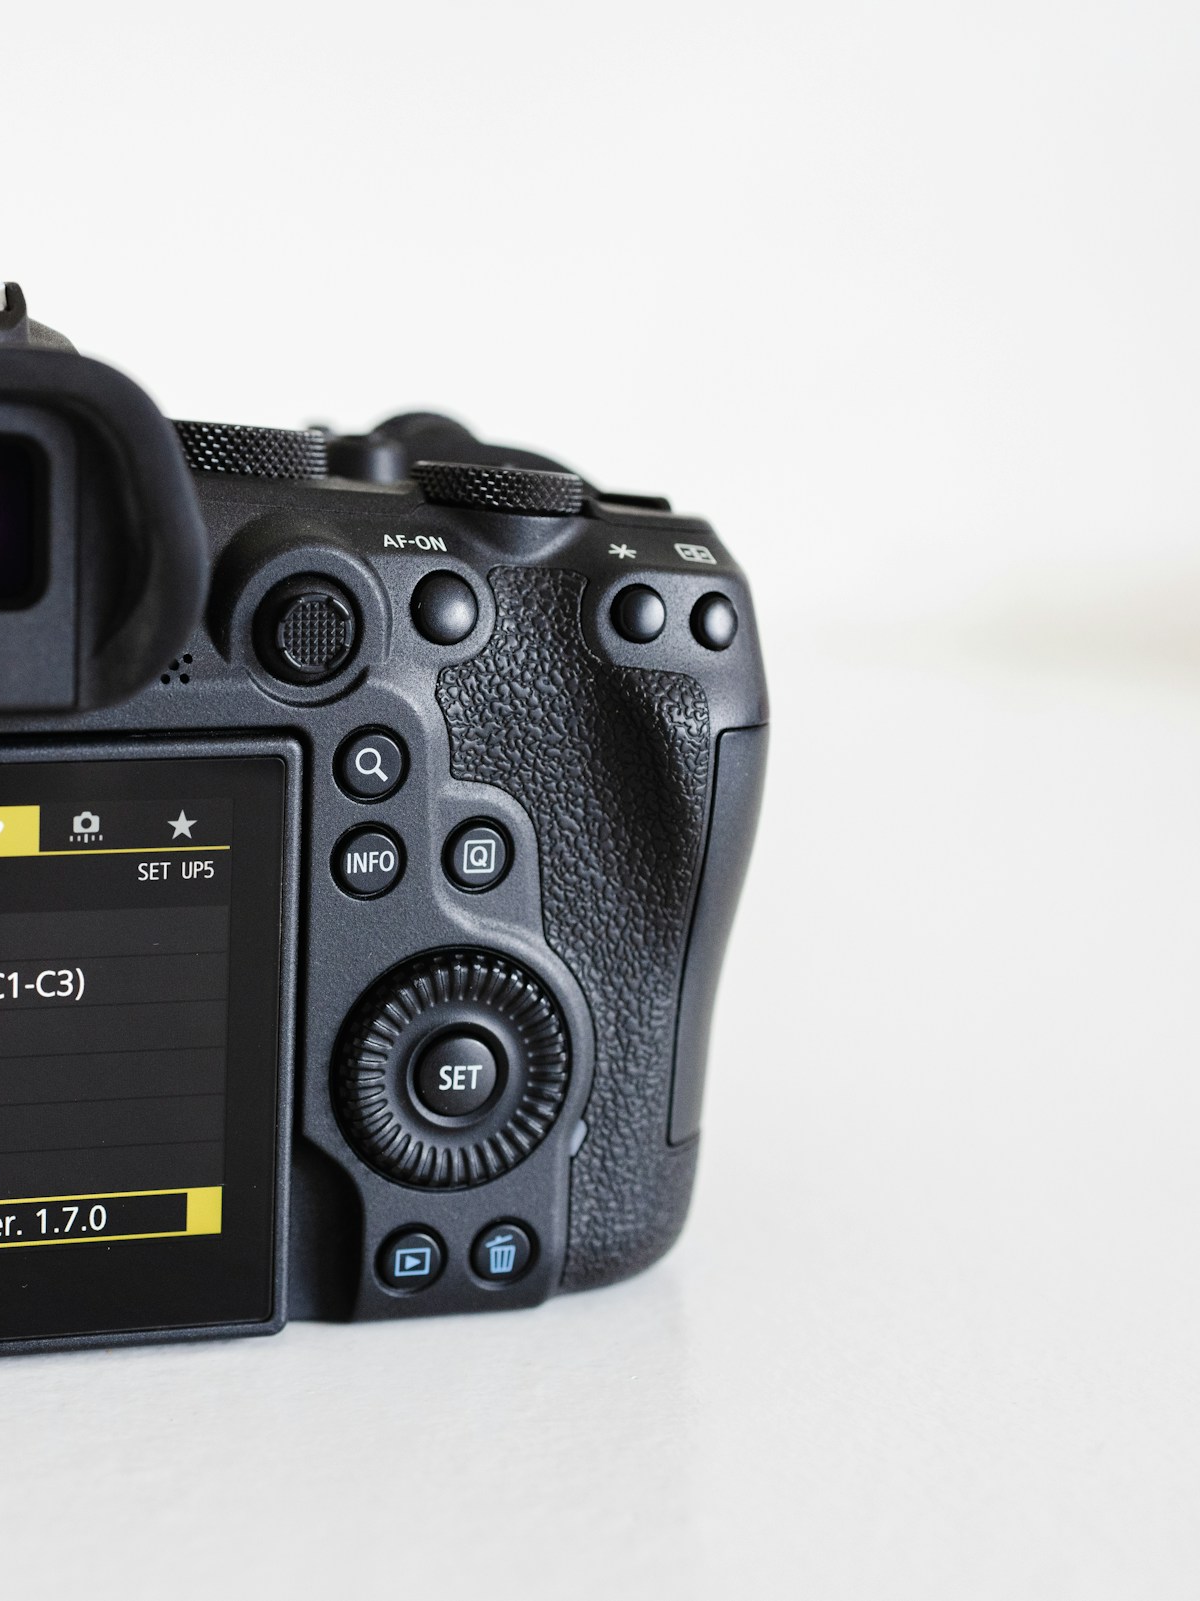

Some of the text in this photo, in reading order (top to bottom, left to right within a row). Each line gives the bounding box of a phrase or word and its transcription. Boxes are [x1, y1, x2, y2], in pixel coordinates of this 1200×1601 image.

[383, 534, 448, 552] AF-ON
[346, 850, 395, 874] INFO
[470, 845, 488, 867] Q
[137, 860, 215, 881] SET UP5
[438, 1064, 483, 1091] SET
[36, 1204, 107, 1234] 1.7.0
